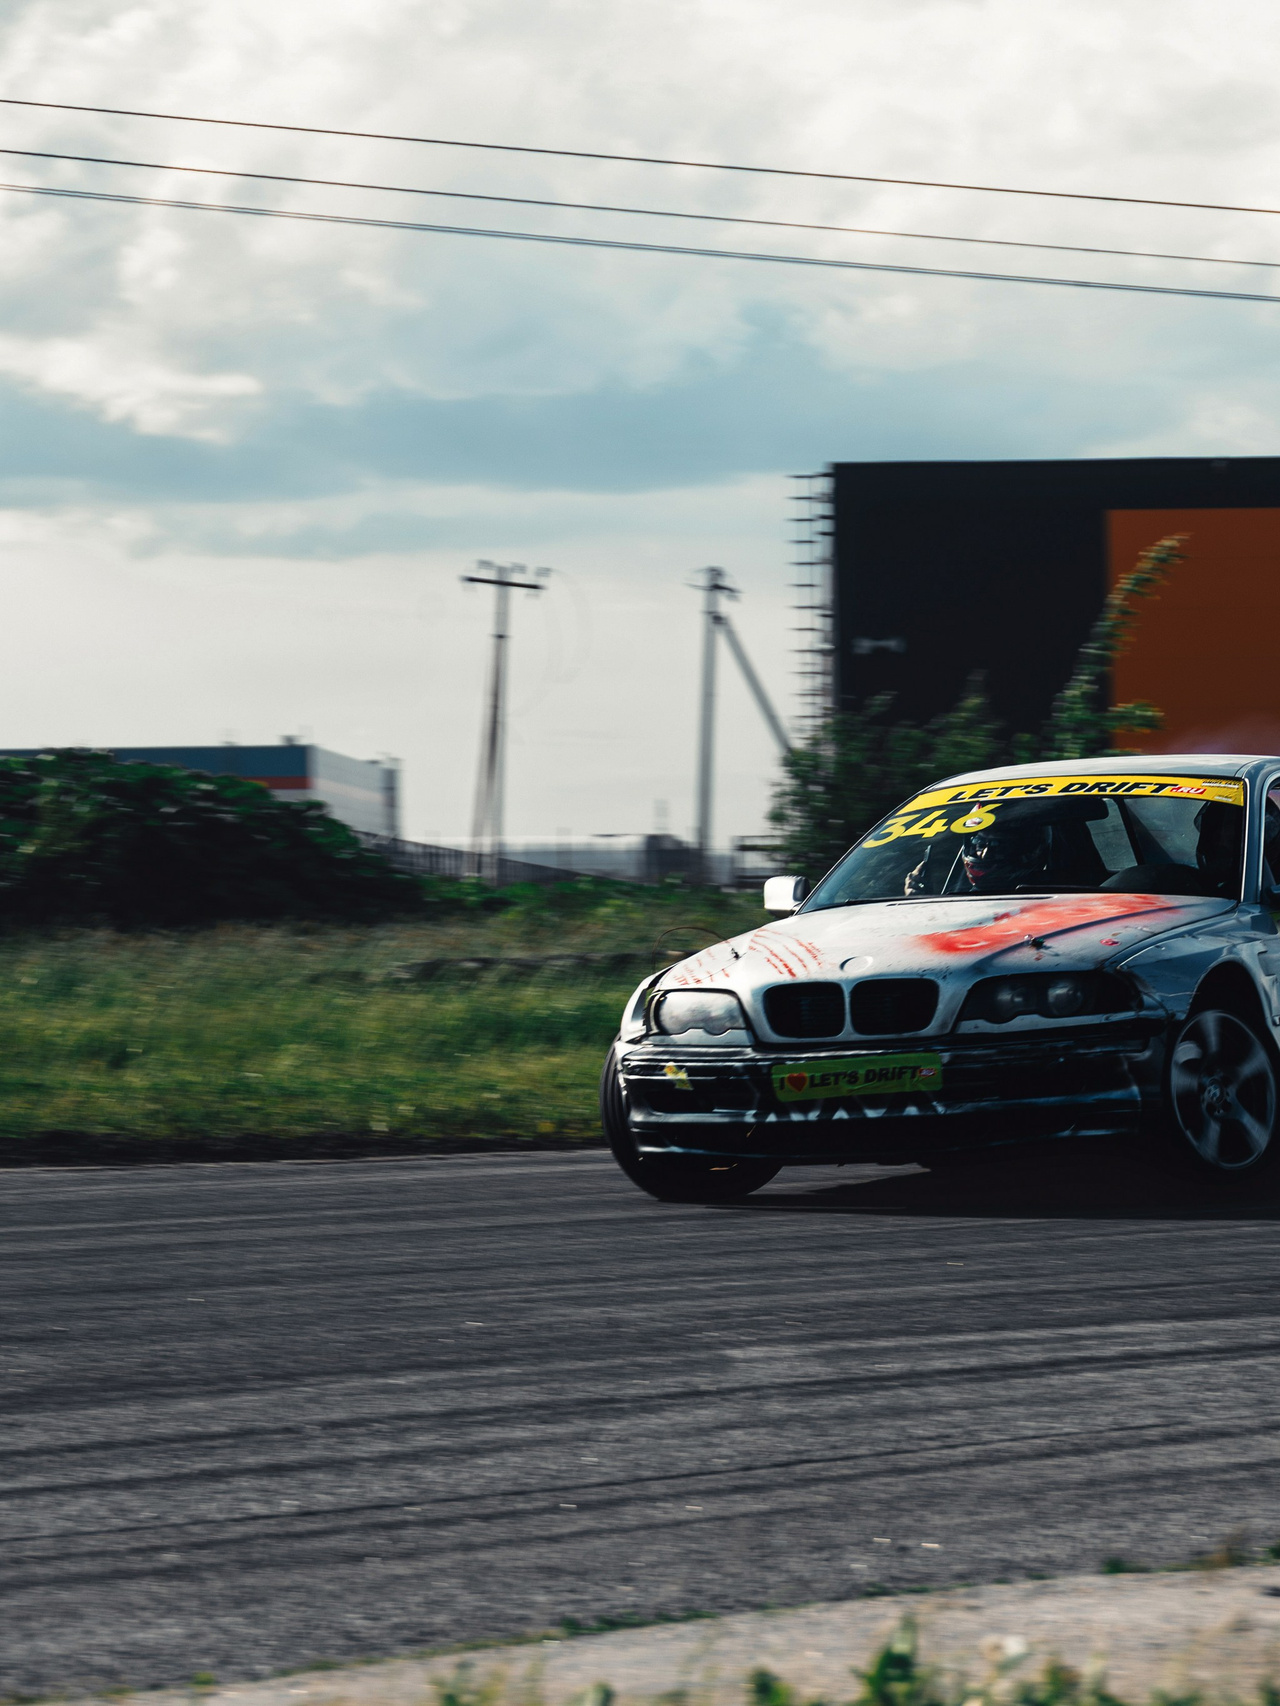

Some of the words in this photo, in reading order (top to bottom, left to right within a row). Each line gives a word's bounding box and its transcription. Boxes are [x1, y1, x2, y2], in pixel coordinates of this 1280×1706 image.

[947, 783, 1053, 802] LET'S
[862, 803, 1003, 848] 346
[809, 1070, 859, 1088] LET'S
